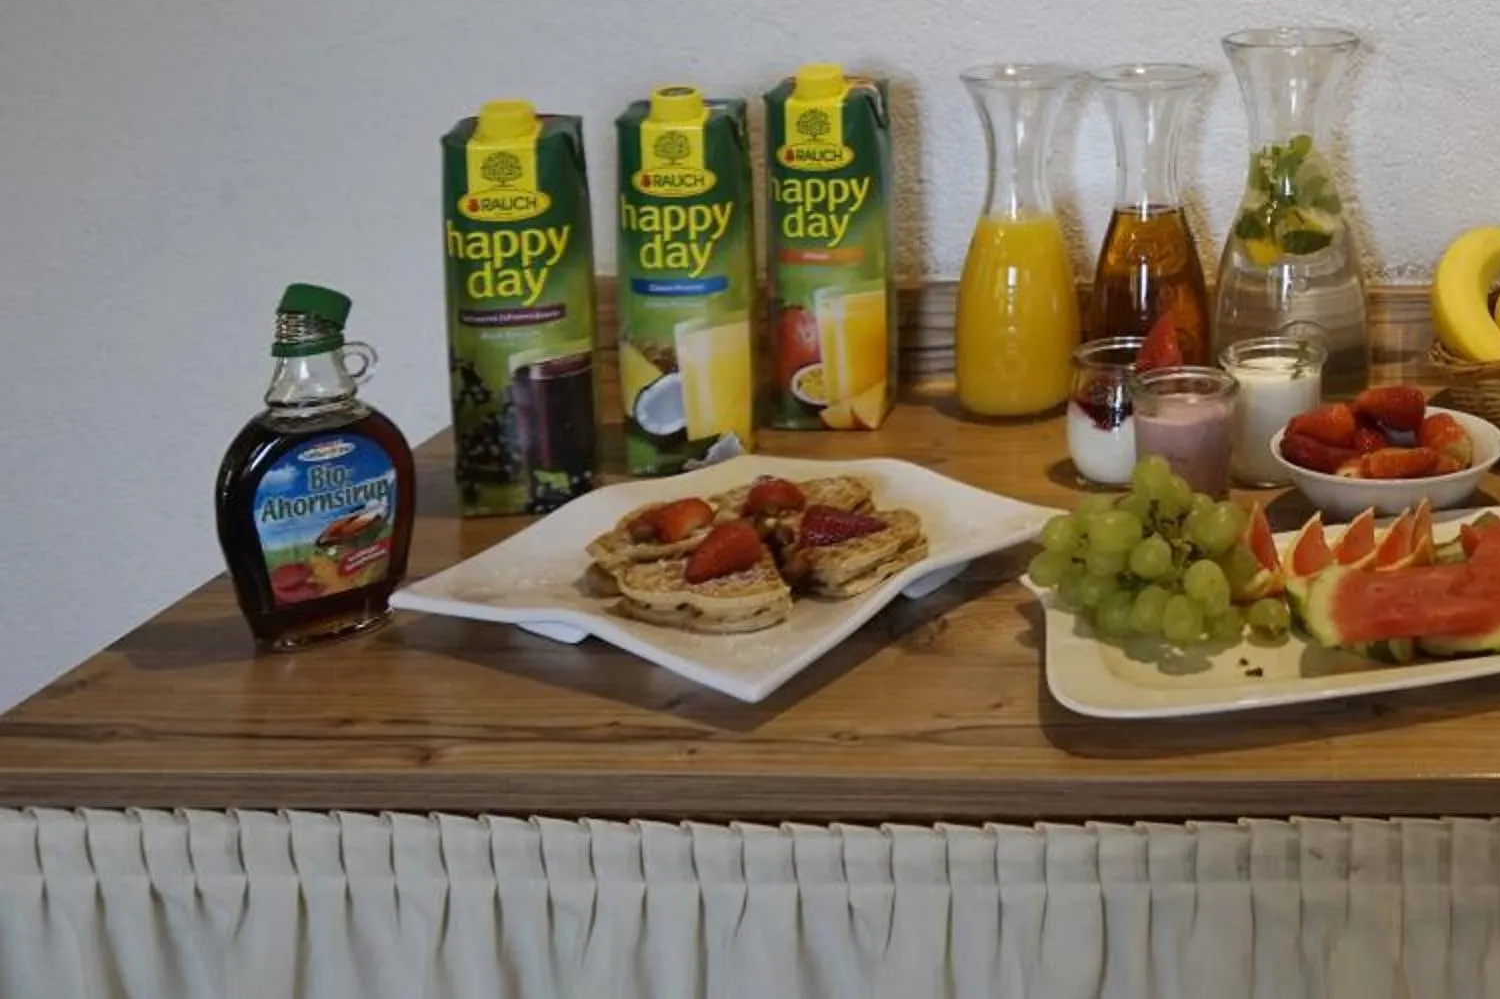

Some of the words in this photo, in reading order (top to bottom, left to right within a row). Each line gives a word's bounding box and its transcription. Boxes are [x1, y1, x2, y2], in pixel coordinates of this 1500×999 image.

[795, 148, 843, 162] RAUCH
[653, 173, 705, 189] RAUCH
[480, 196, 538, 212] RAUCH
[620, 193, 733, 241] happy
[783, 204, 851, 248] day
[446, 219, 571, 269] happy
[640, 233, 713, 278] day
[467, 261, 549, 307] day
[261, 478, 390, 523] Ahornsirup
